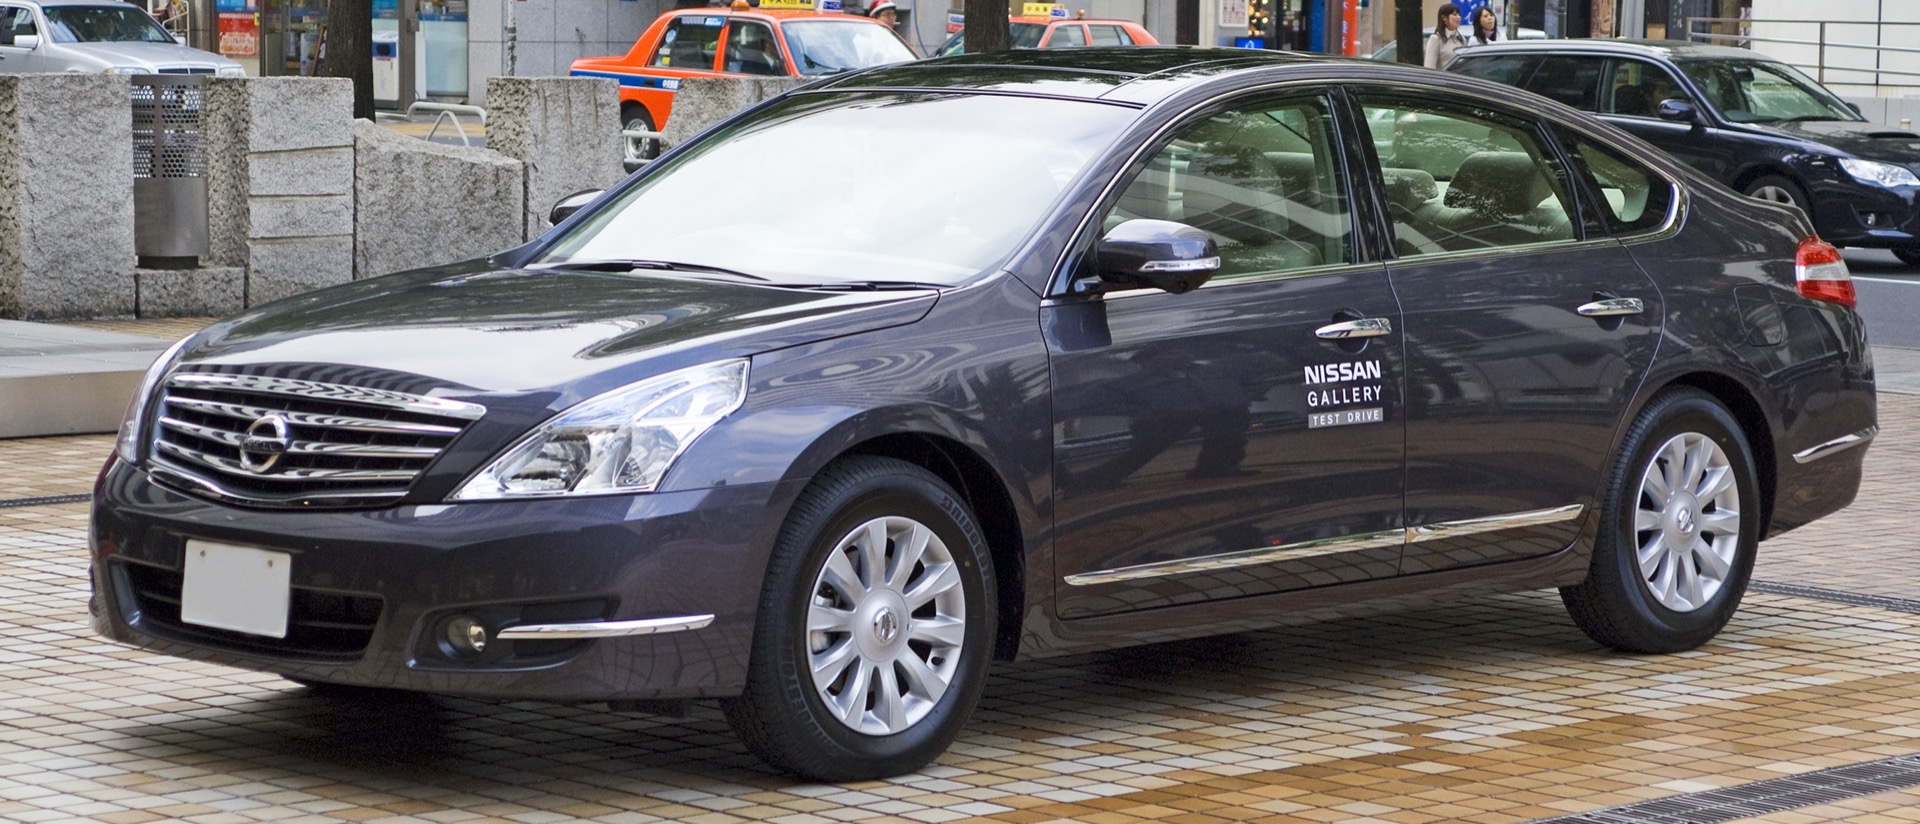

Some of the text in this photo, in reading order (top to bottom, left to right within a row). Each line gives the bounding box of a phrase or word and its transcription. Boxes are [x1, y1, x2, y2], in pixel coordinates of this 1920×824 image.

[1304, 360, 1381, 385] NISSAN
[1307, 385, 1382, 407] GALLERY
[1313, 410, 1379, 425] TEST DRIVE
